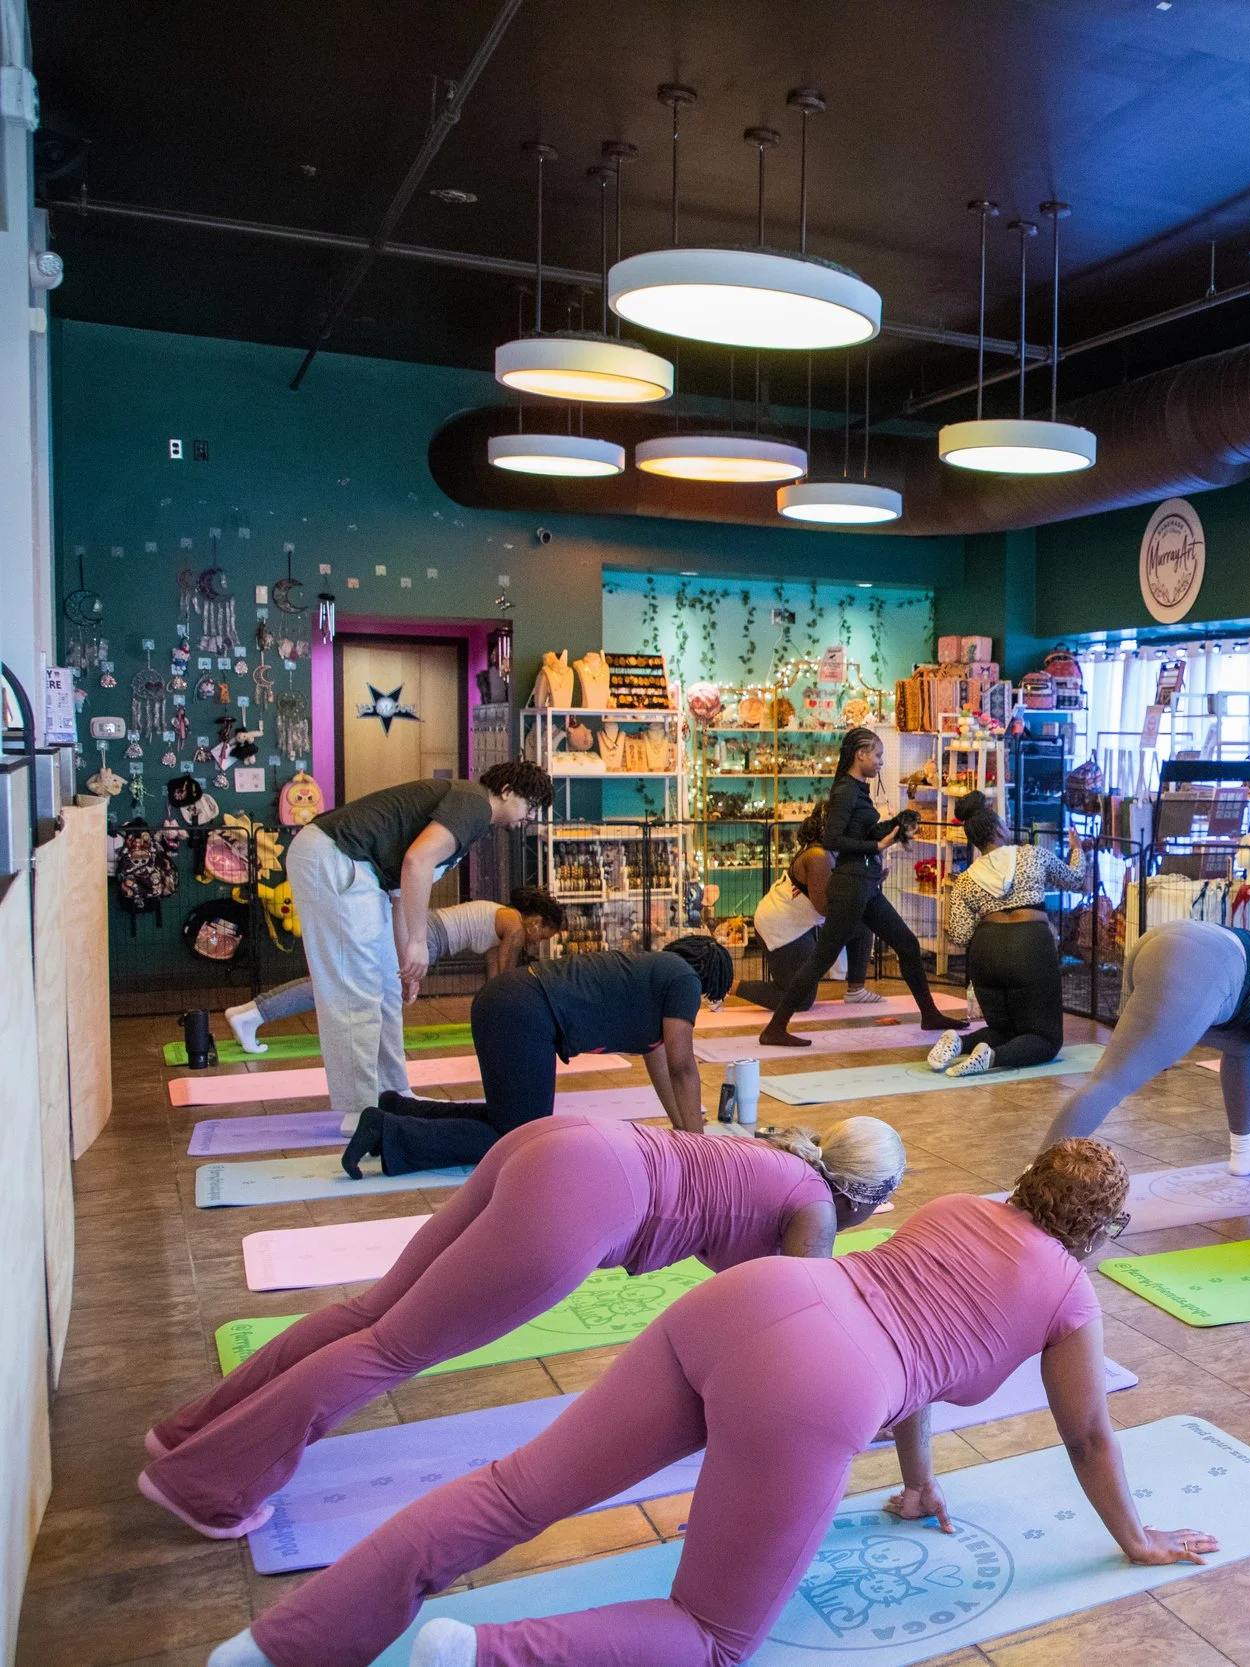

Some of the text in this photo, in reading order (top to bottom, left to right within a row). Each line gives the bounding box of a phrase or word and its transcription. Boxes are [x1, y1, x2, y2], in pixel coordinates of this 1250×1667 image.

[586, 1274, 660, 1284] URRY
[1181, 1422, 1212, 1438] find
[1201, 1434, 1234, 1451] your
[870, 1599, 981, 1641] YOGA
